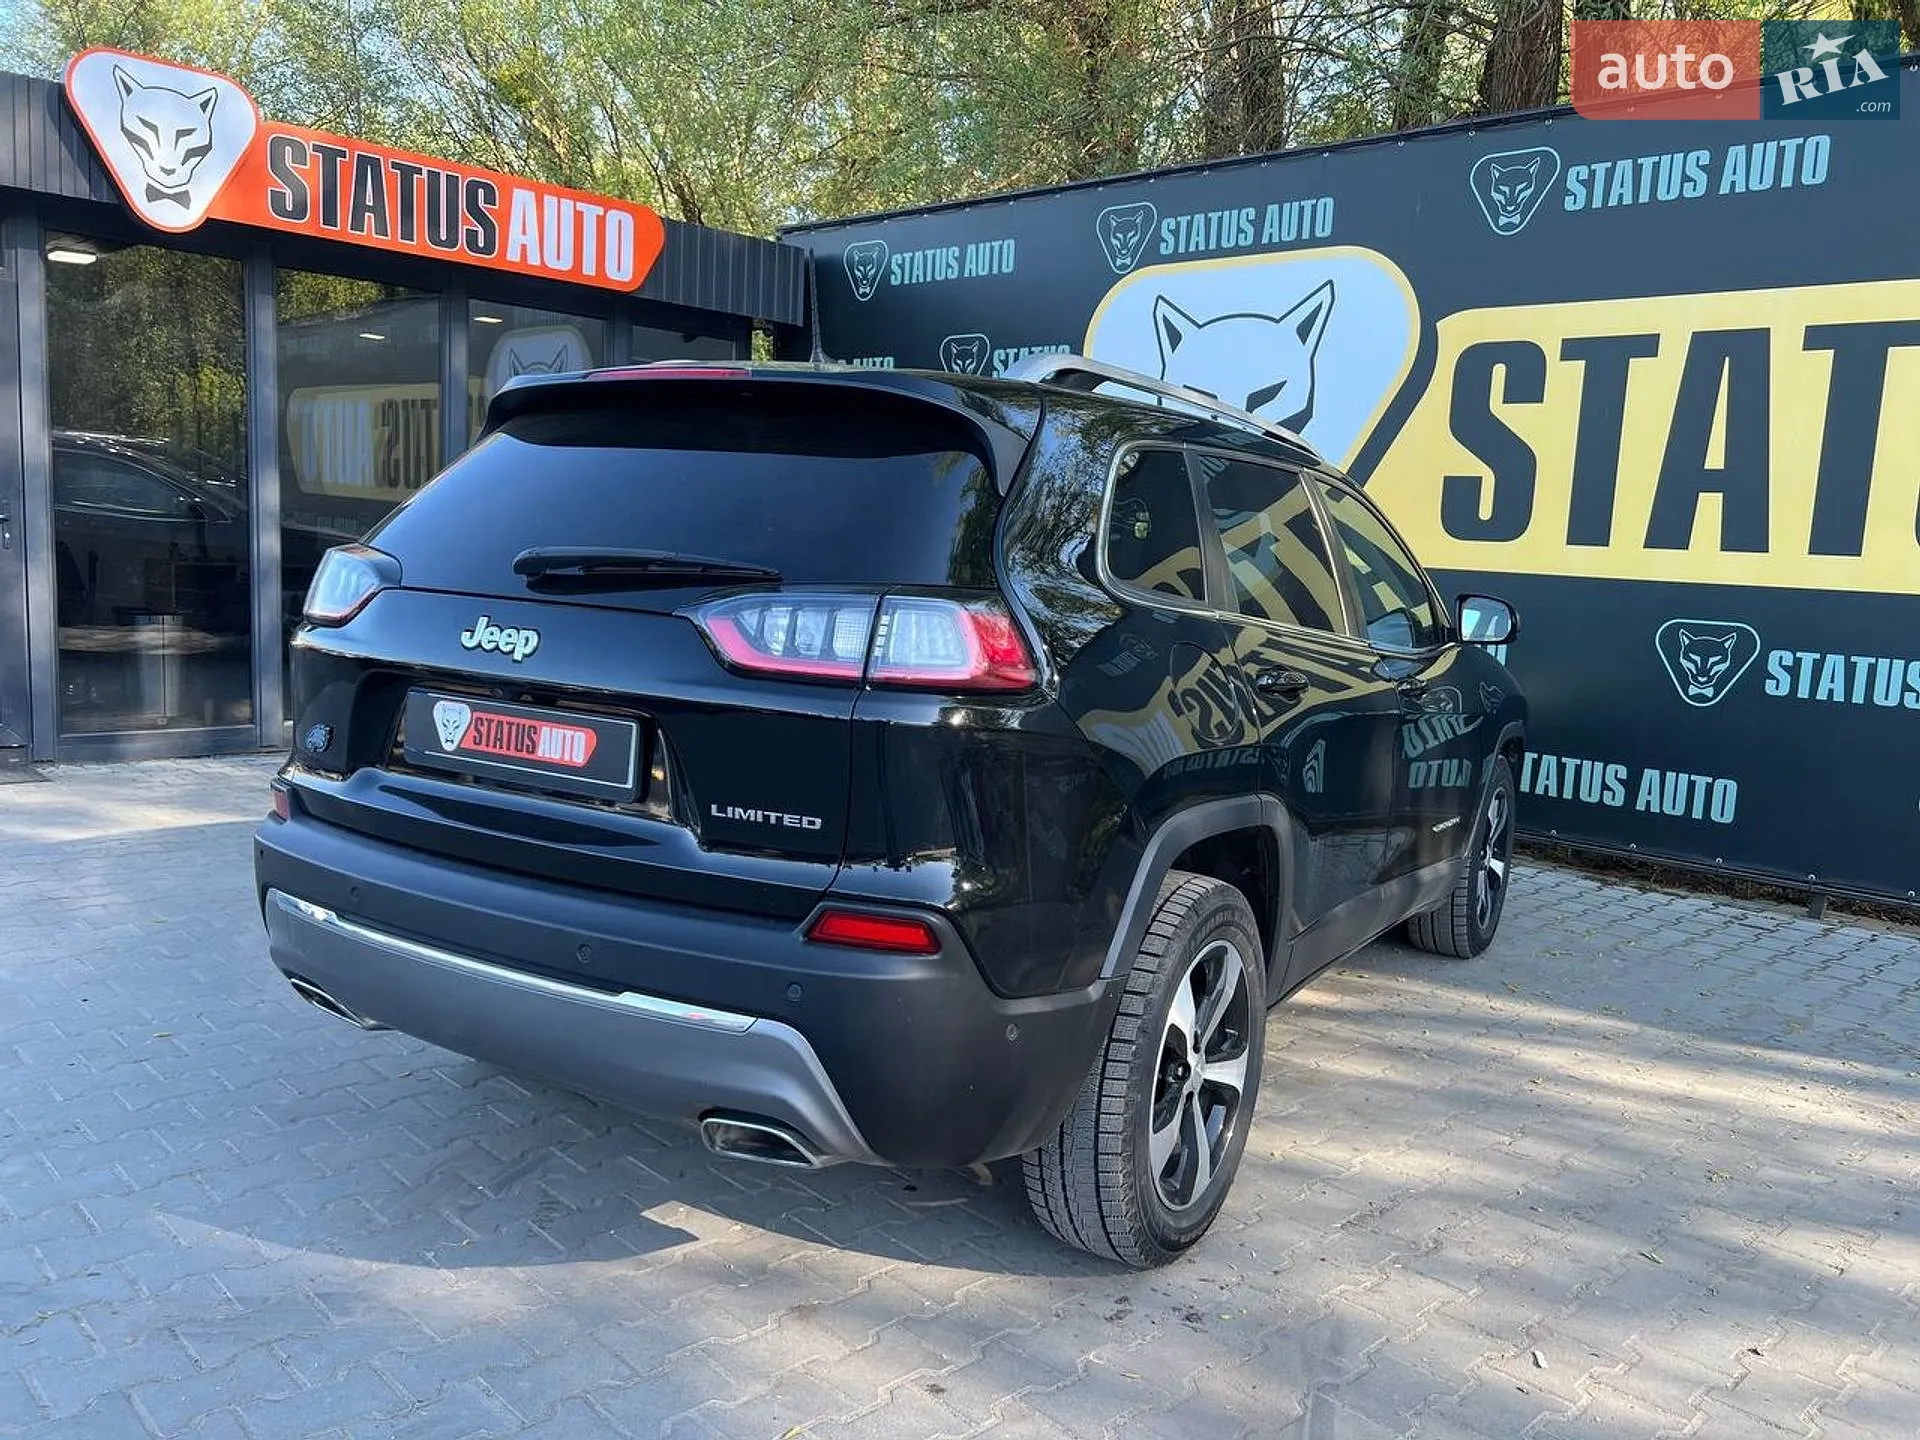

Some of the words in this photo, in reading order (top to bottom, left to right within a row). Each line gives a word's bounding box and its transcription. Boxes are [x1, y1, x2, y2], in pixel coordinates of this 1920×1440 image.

[1564, 148, 1711, 212] STATUS
[1719, 134, 1832, 195] AUTO
[266, 134, 500, 258] STATUS
[505, 186, 635, 283] AUTO
[1159, 207, 1255, 255] STATUS
[1261, 197, 1335, 245] AUTO
[889, 247, 961, 286] STATUS
[963, 238, 1016, 279] AUTO
[1441, 320, 1920, 557] STAT
[460, 615, 541, 662] Jeep
[473, 717, 537, 755] STATUS
[538, 725, 586, 765] AUTO
[711, 803, 823, 831] LIMITED
[1519, 751, 1628, 807] TATUS
[1635, 768, 1738, 825] AUTO
